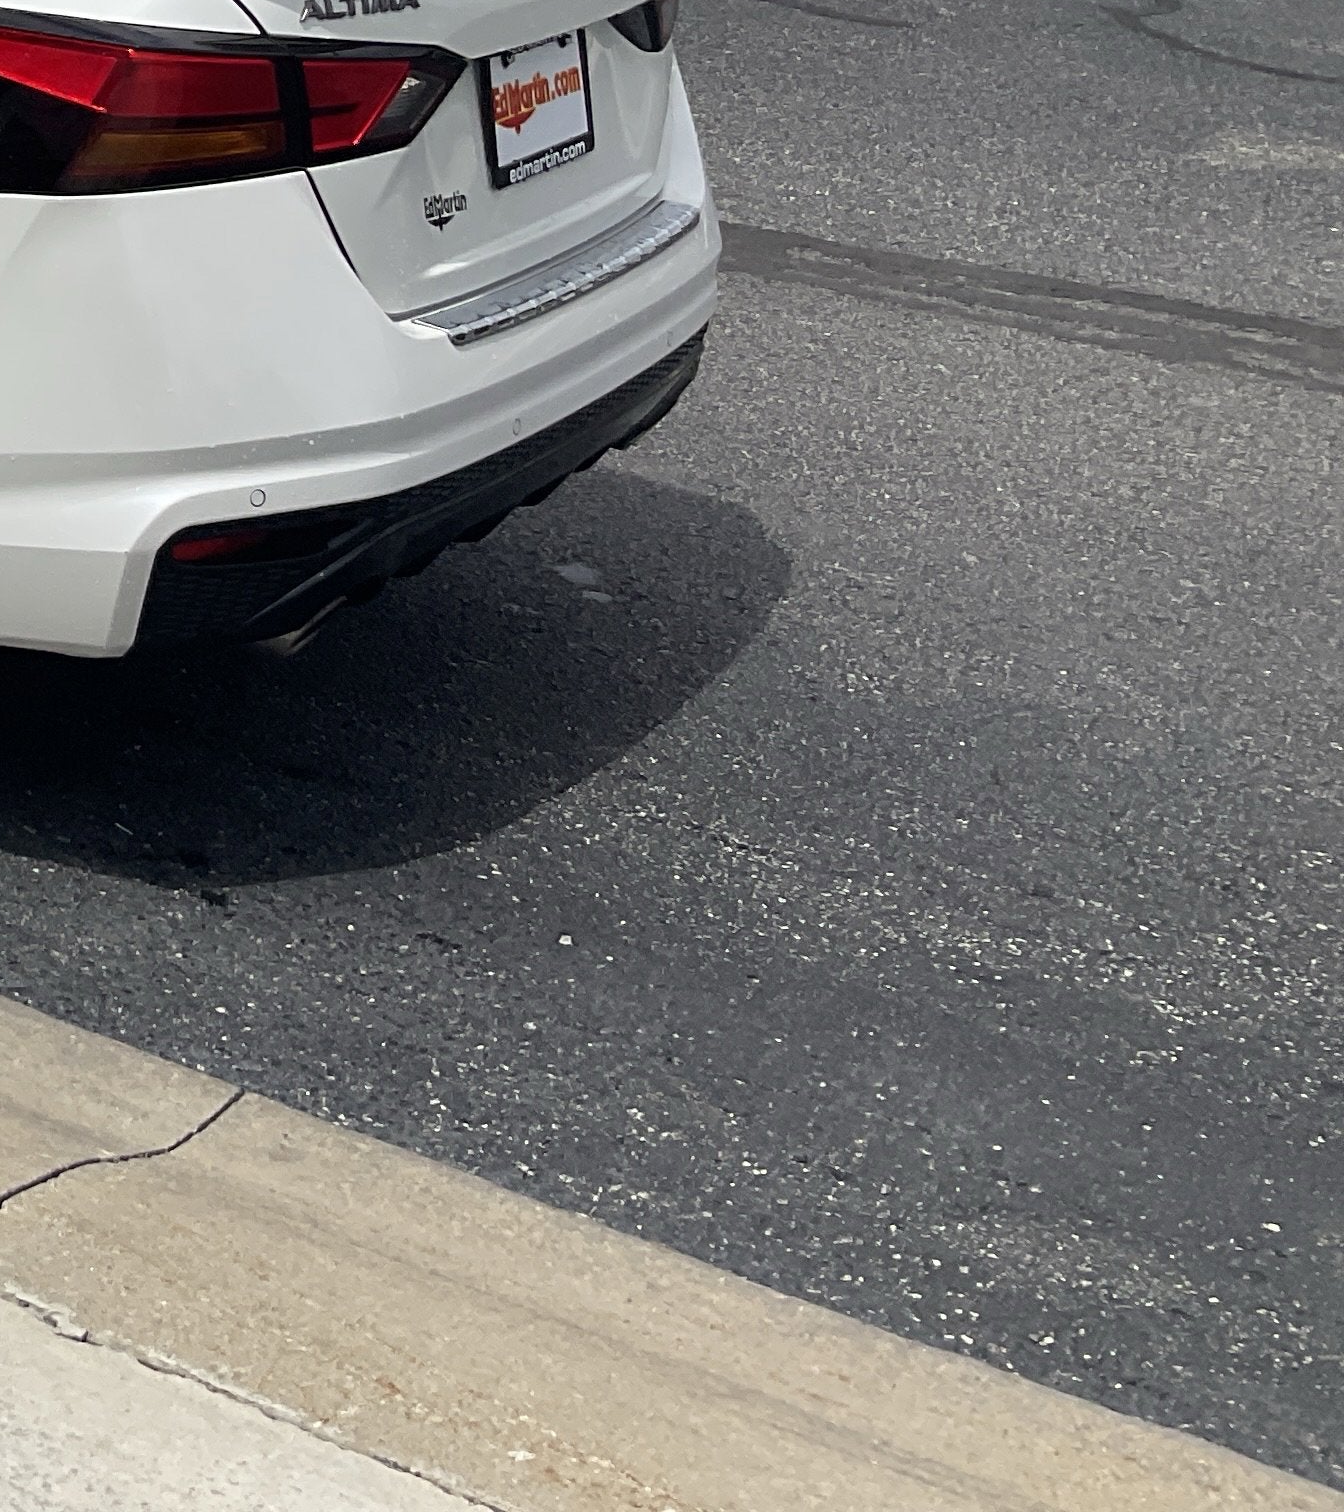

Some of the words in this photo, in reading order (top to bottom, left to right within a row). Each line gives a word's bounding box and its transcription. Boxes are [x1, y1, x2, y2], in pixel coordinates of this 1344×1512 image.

[491, 66, 582, 121] EdMartin.com
[509, 140, 587, 183] edmartin.com
[423, 189, 468, 220] EdMartin
